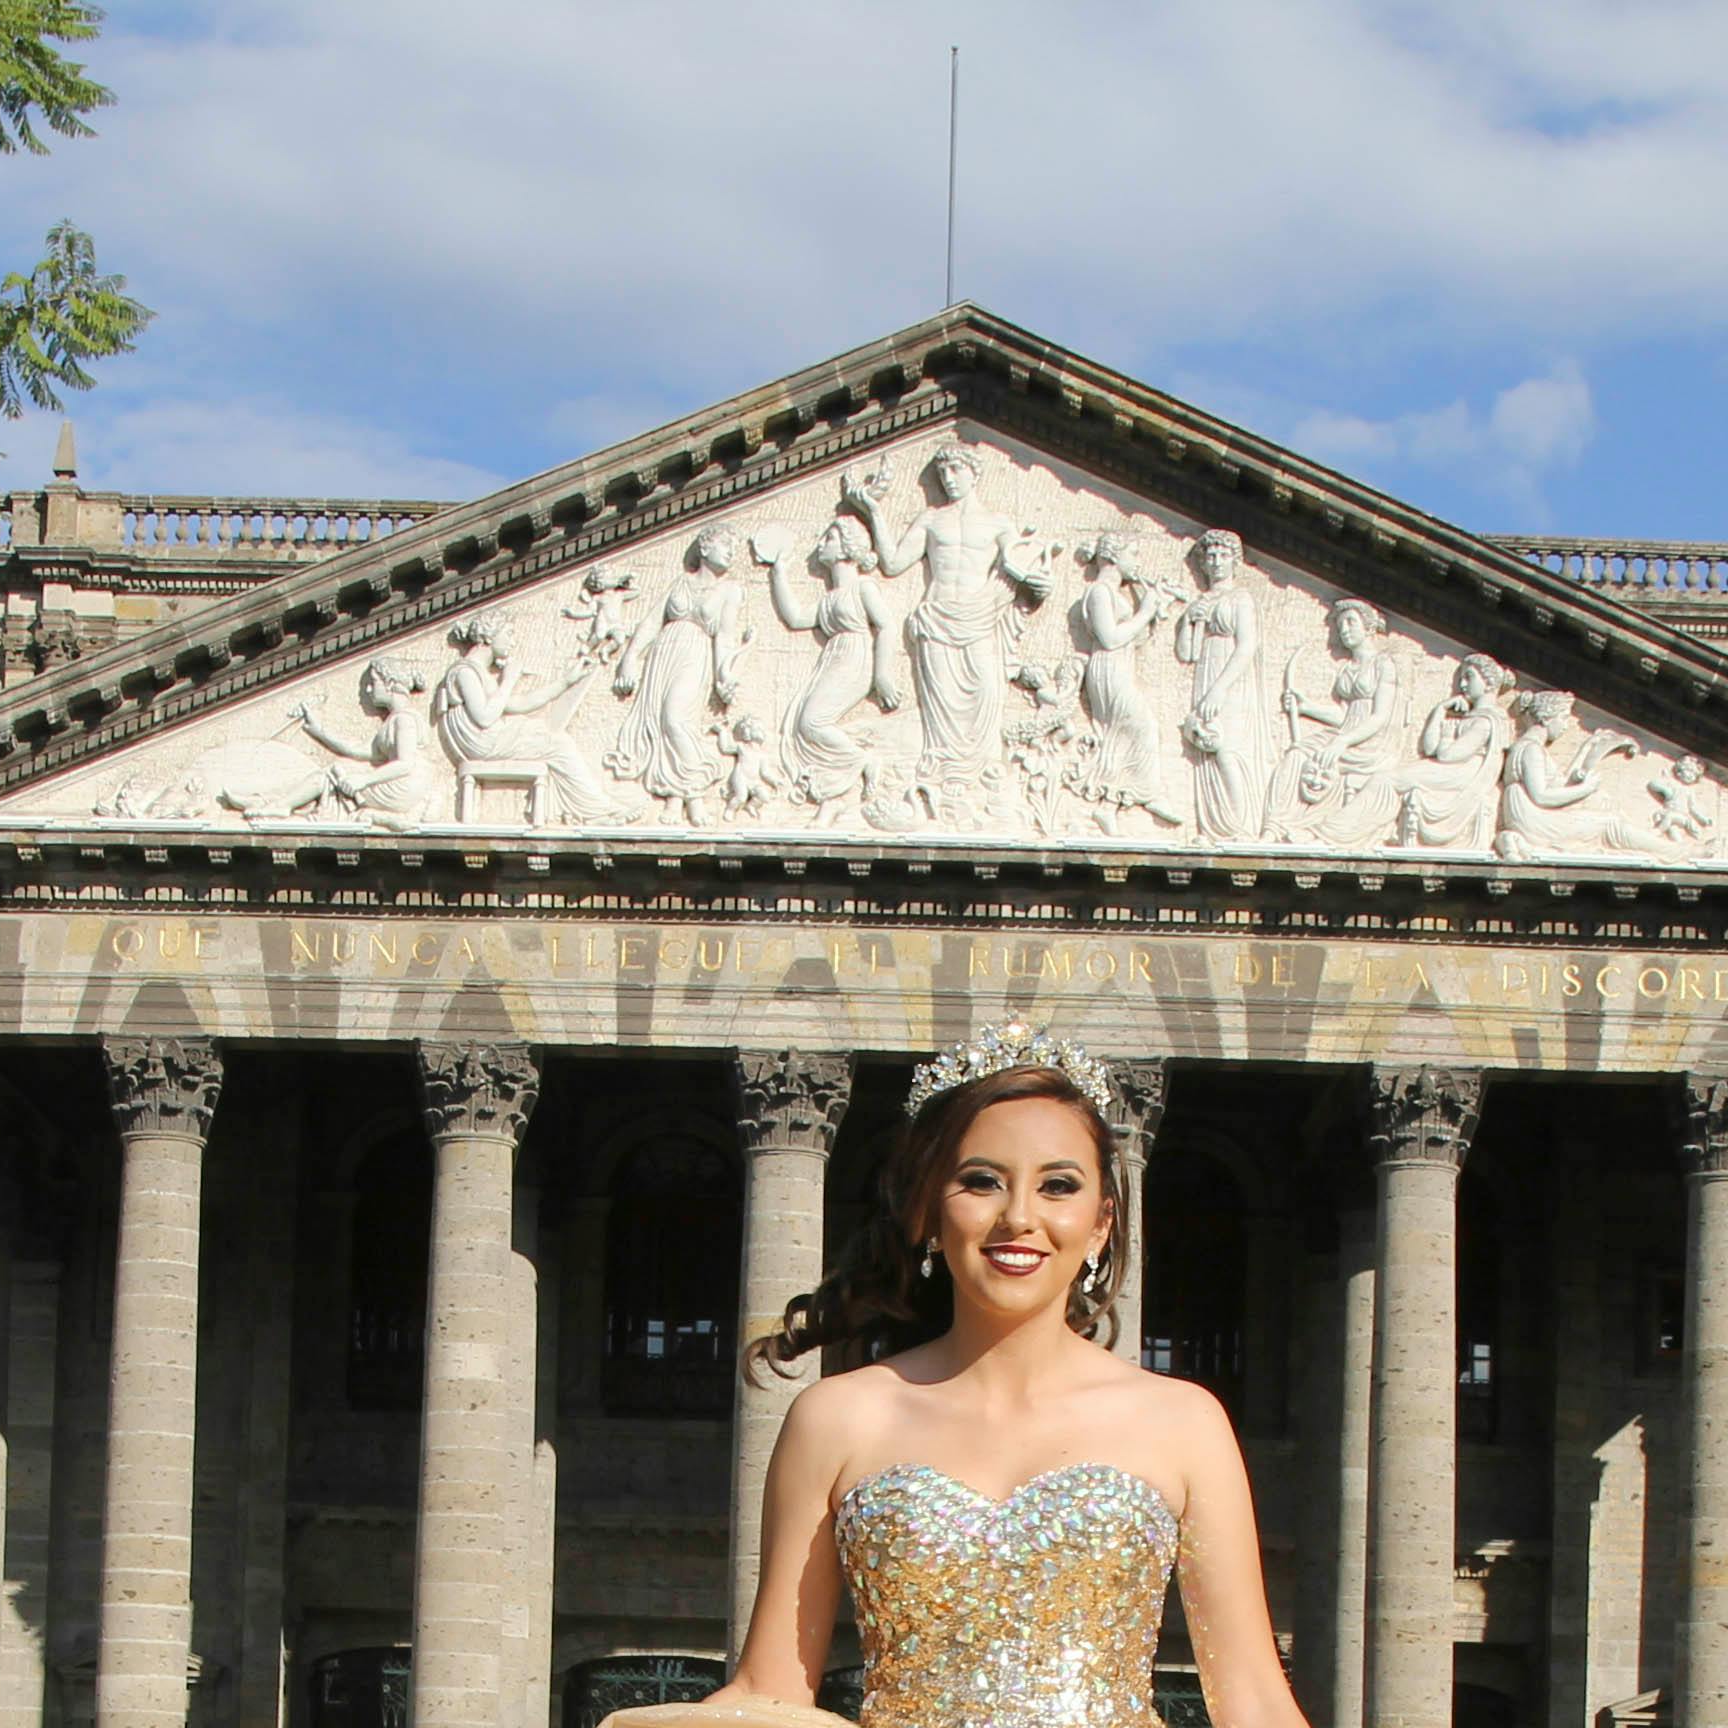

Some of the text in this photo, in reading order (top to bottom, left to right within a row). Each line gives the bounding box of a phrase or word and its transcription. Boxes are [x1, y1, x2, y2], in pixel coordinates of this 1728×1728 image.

[111, 922, 221, 962] QUE
[290, 929, 477, 965] NUNCA
[551, 934, 760, 972] LLEGUE
[831, 940, 891, 974] EL
[968, 945, 1156, 983] RUMOR
[1232, 950, 1297, 986] DE
[1365, 961, 1430, 991] LA
